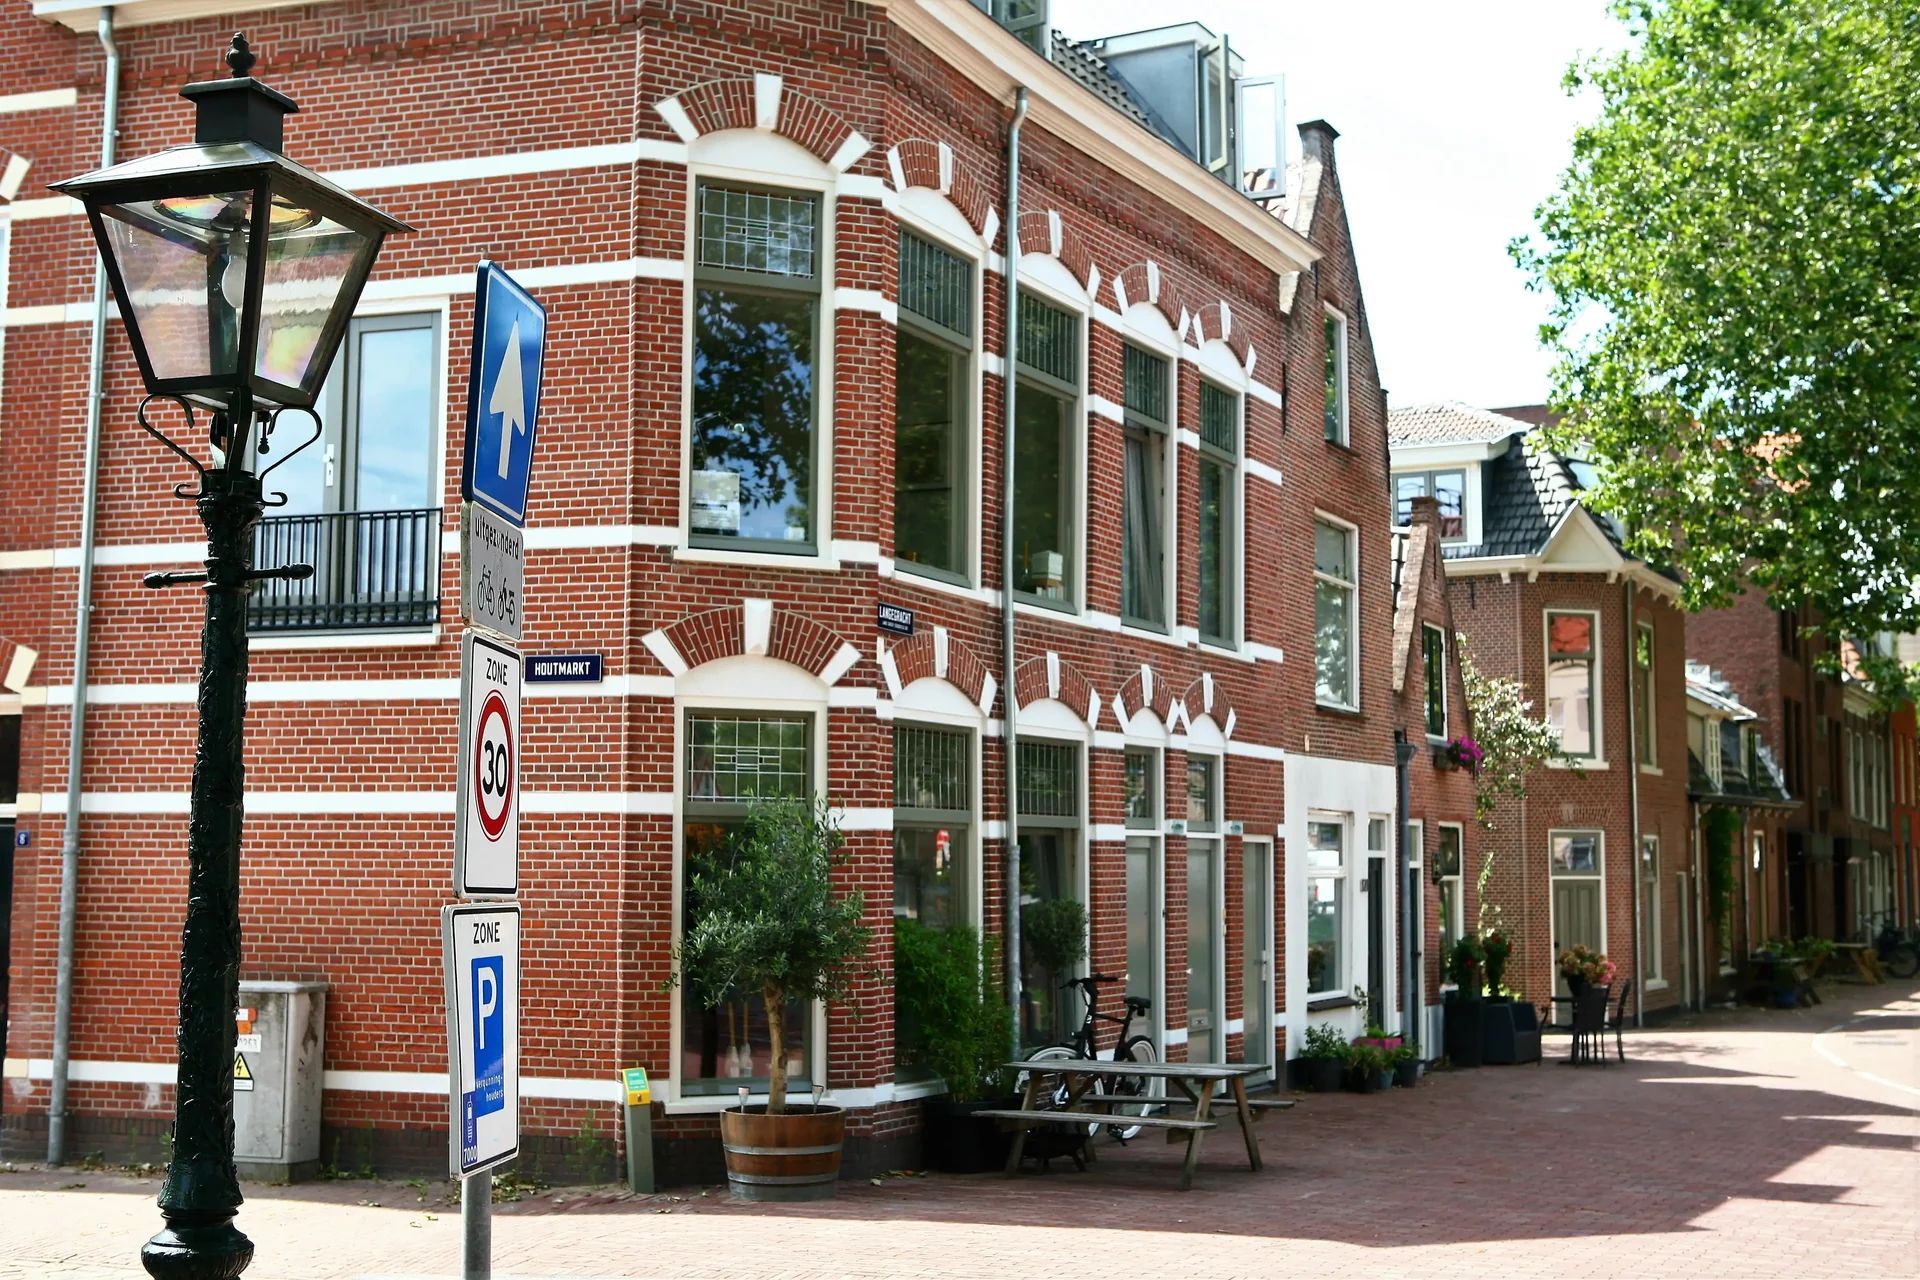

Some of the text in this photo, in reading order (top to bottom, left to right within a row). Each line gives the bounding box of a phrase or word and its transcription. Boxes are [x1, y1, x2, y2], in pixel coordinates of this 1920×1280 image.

[475, 515, 519, 560] uitgezonderd
[486, 657, 508, 686] ZONE
[534, 661, 591, 676] HOUTMARKT
[482, 739, 508, 797] 30
[473, 921, 501, 944] ZONE
[477, 966, 498, 1050] P
[485, 1089, 504, 1102] houders
[463, 1145, 478, 1163] 7000
